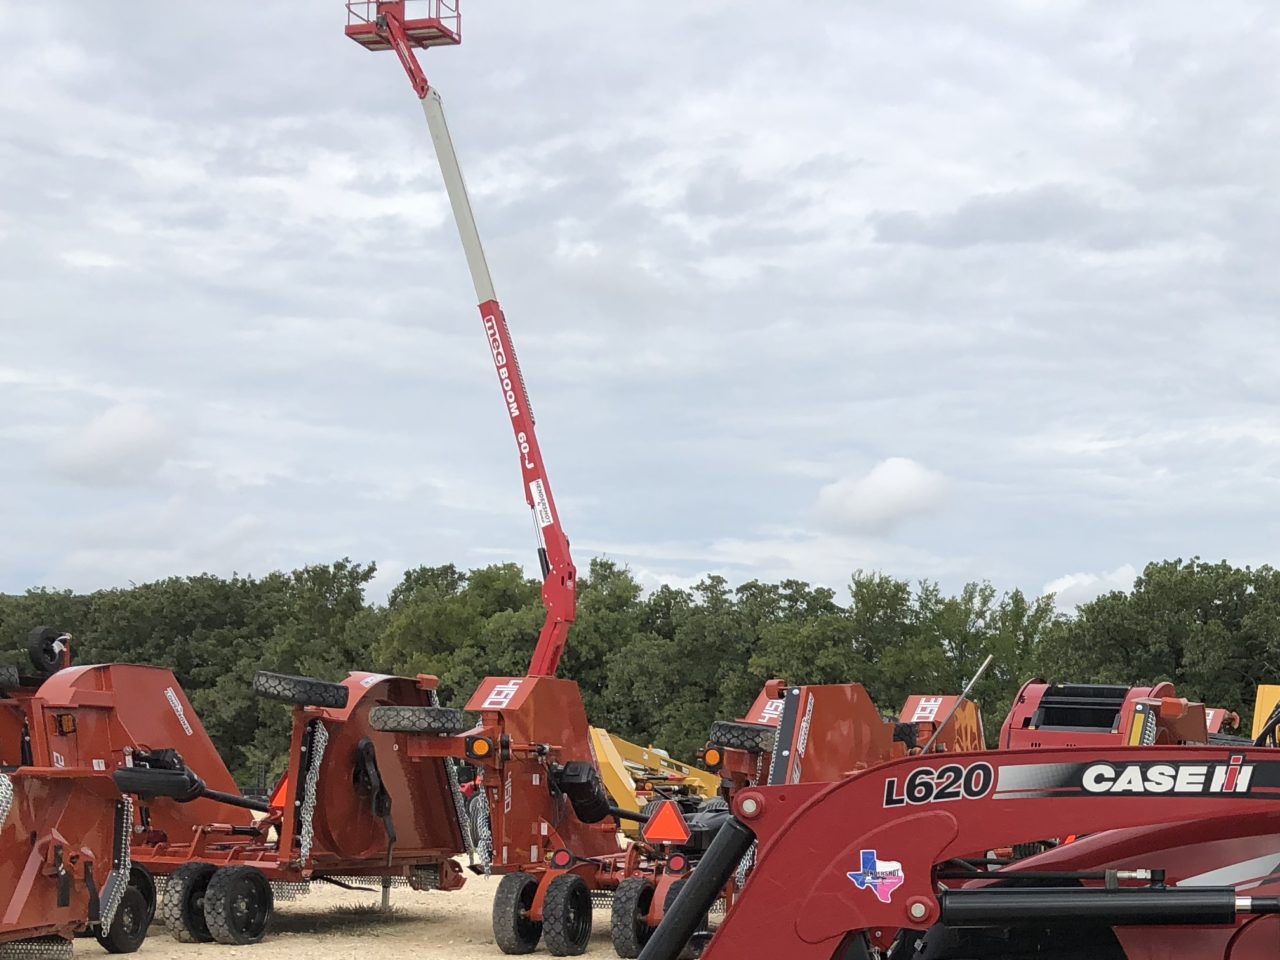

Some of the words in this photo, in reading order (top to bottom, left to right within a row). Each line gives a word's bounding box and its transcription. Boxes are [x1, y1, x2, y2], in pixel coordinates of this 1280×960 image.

[500, 366, 520, 417] BOOM
[517, 431, 534, 469] 60-J
[481, 679, 523, 709] 4150
[883, 761, 994, 808] L620
[1082, 765, 1207, 793] CASE
